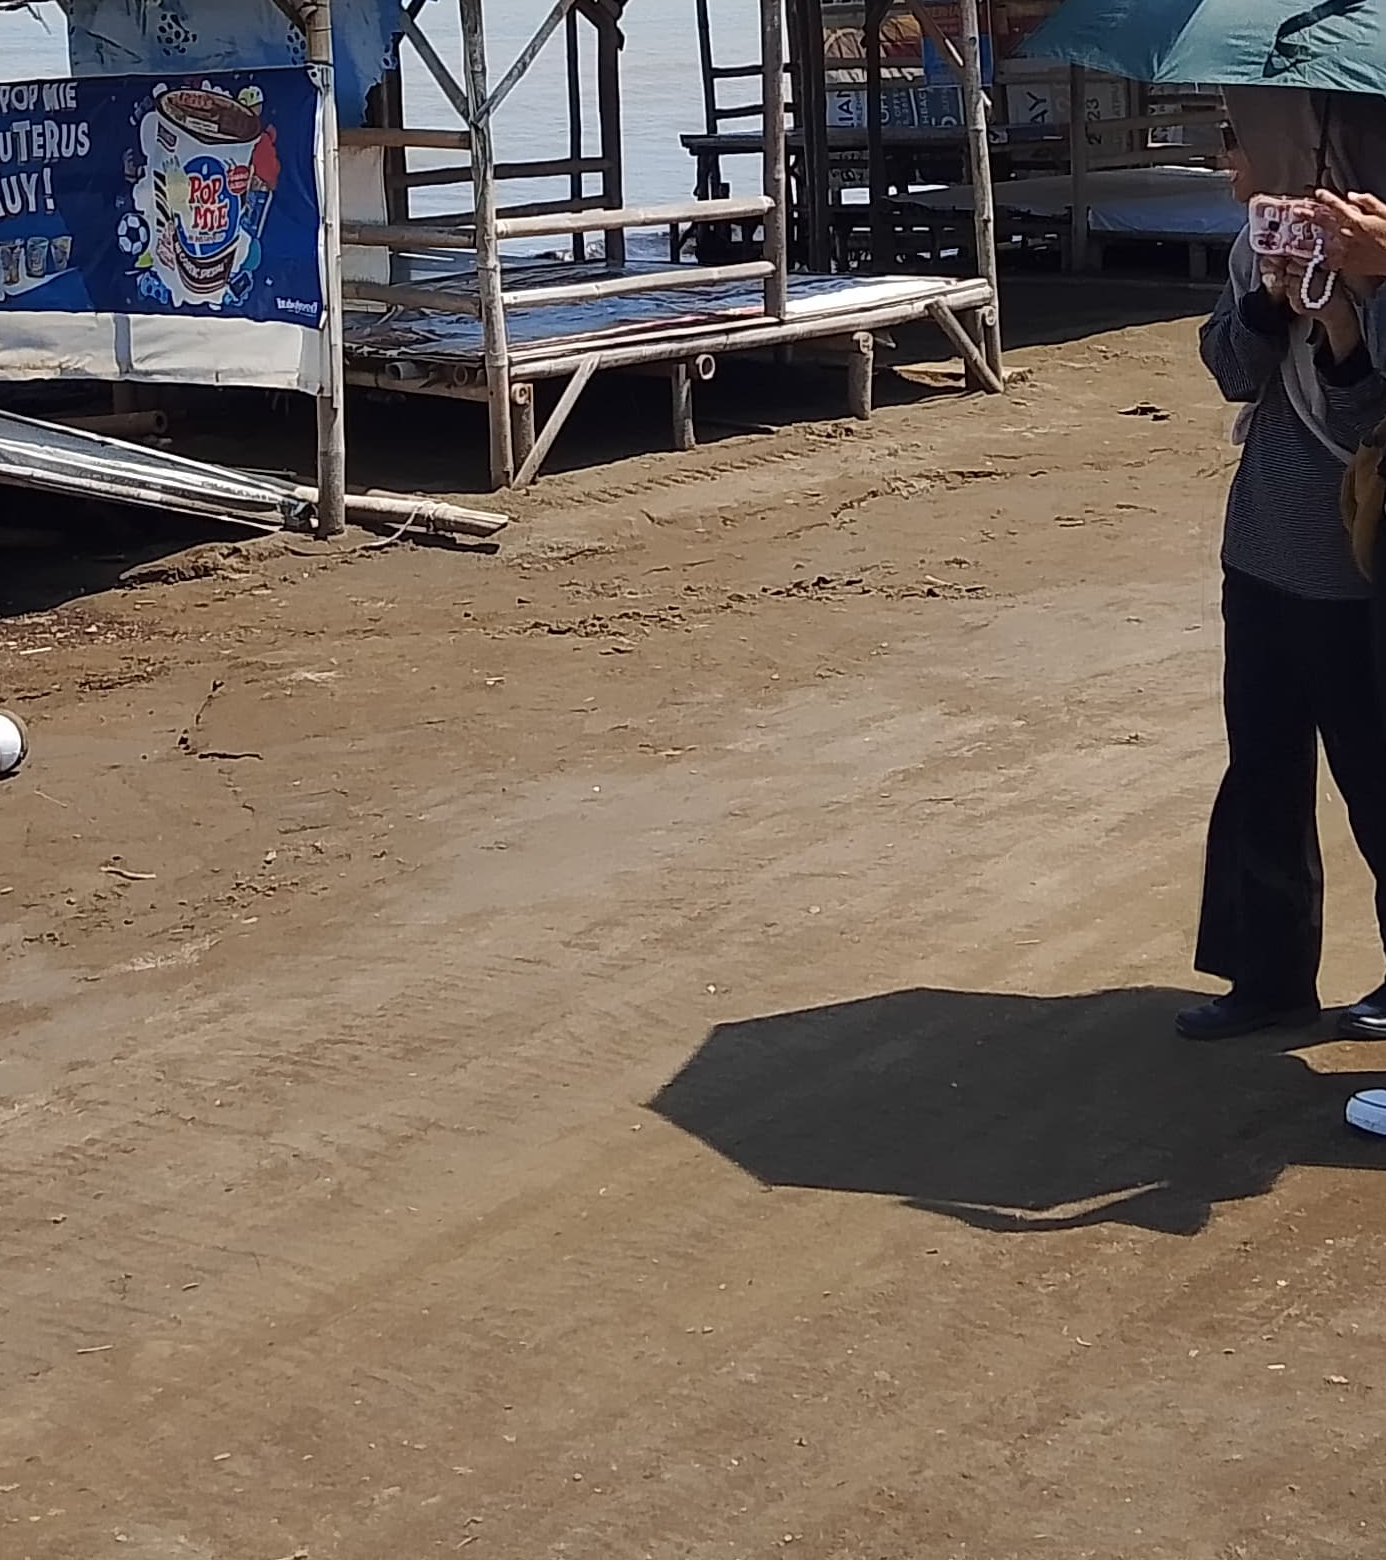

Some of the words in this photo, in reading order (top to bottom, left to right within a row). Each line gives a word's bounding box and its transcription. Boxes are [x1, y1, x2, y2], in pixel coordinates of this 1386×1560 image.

[42, 82, 78, 112] MIE
[188, 173, 224, 204] POP
[191, 204, 229, 232] MIE
